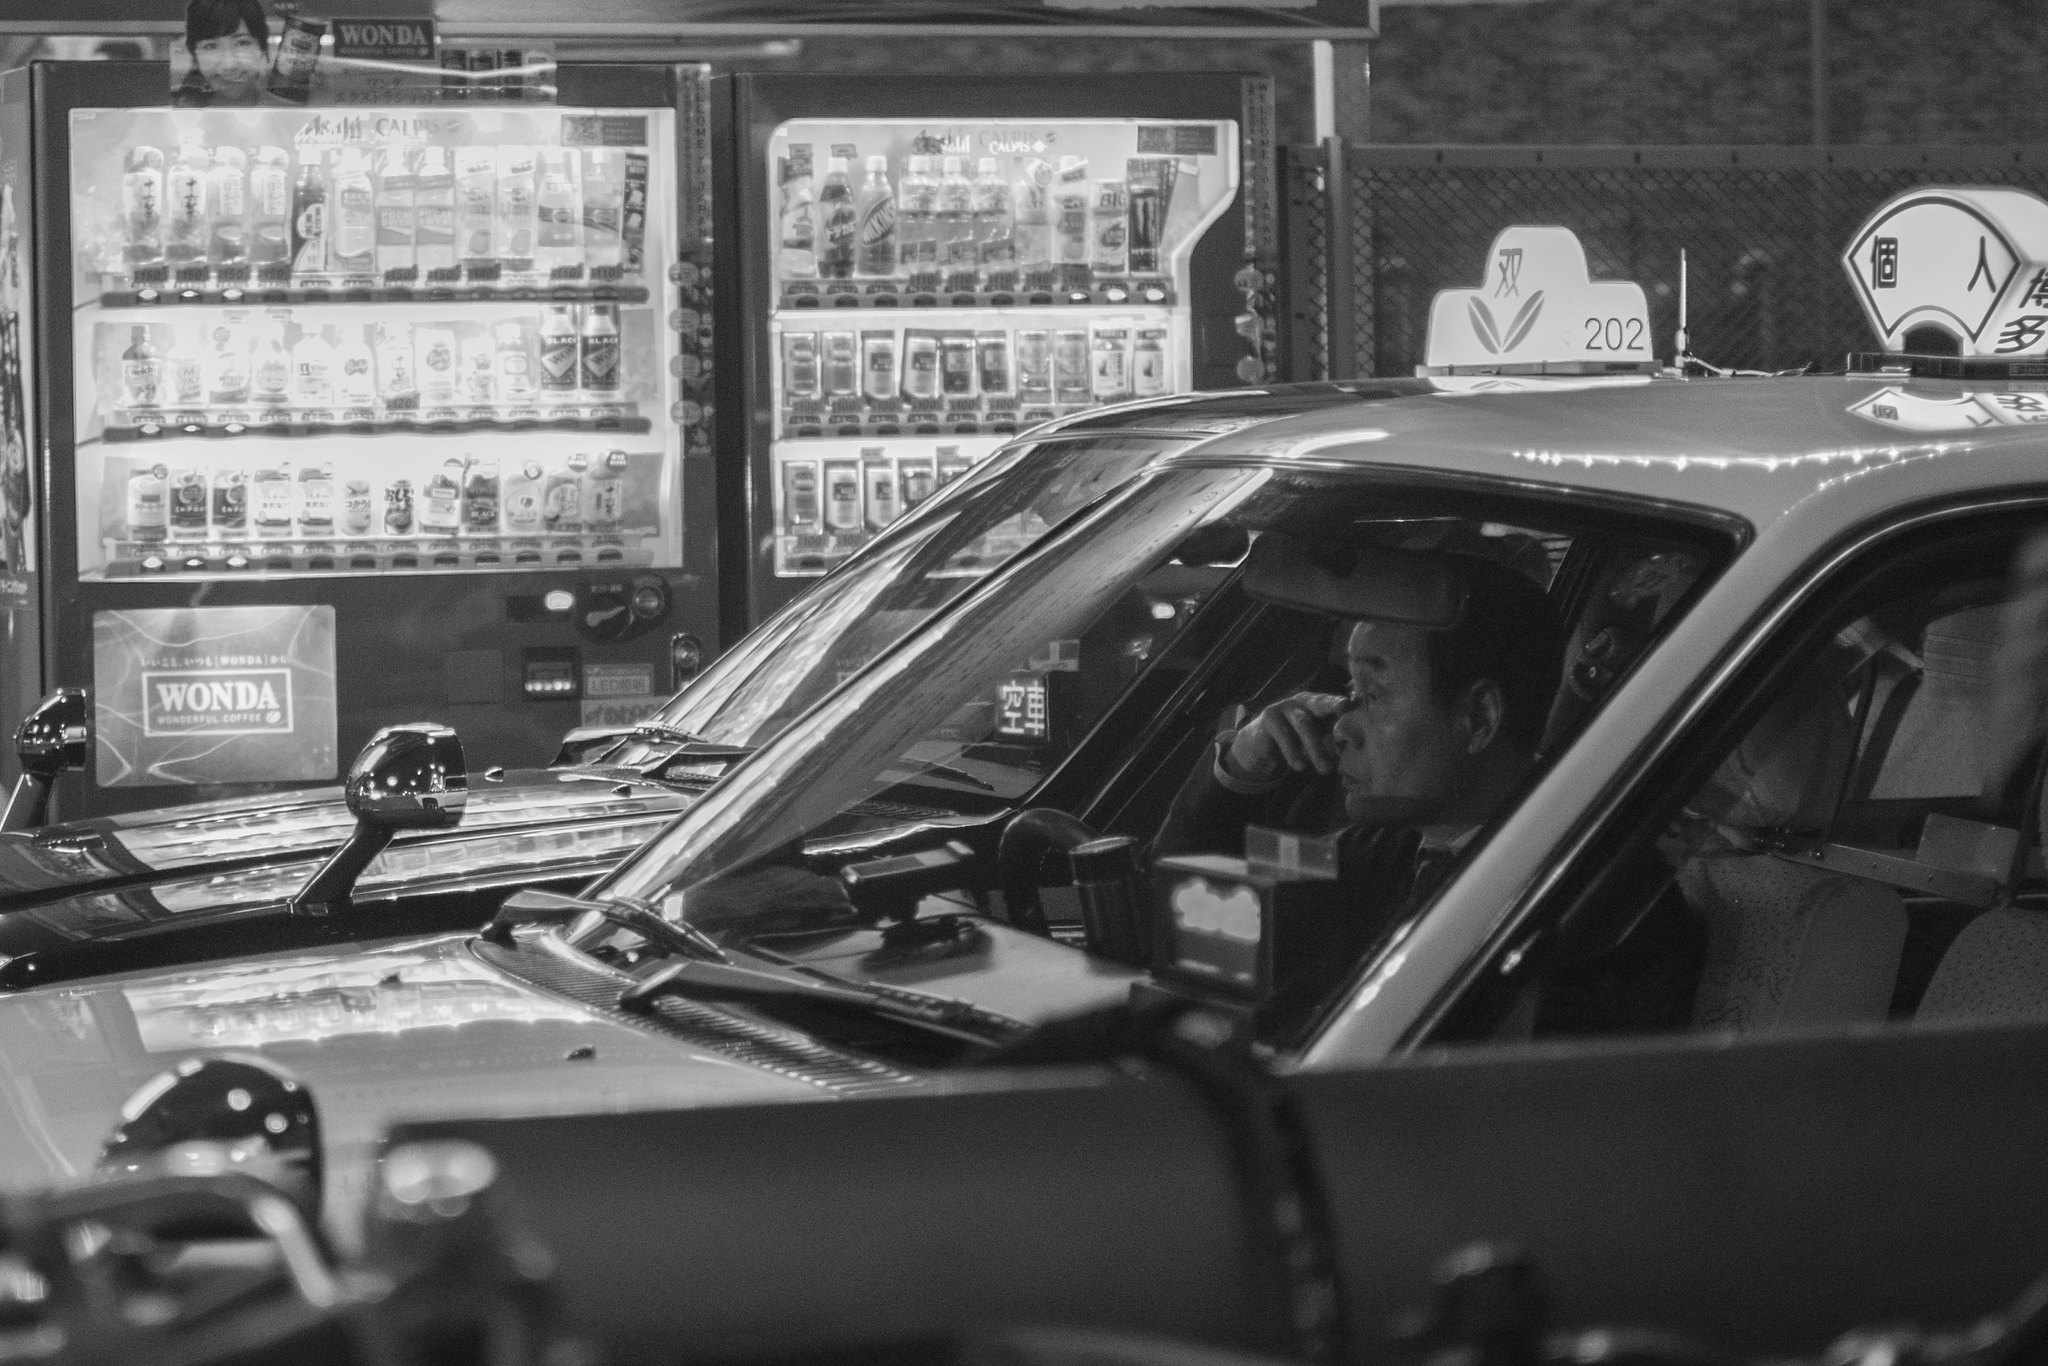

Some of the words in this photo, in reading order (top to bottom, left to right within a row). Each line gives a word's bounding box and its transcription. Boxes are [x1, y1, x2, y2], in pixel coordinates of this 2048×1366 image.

[340, 25, 426, 46] WONDA
[1584, 317, 1644, 351] 202
[156, 680, 281, 713] WONDA
[1000, 679, 1046, 736] 空車
[157, 713, 219, 725] WONDERFUL
[223, 713, 262, 724] COFFEE
